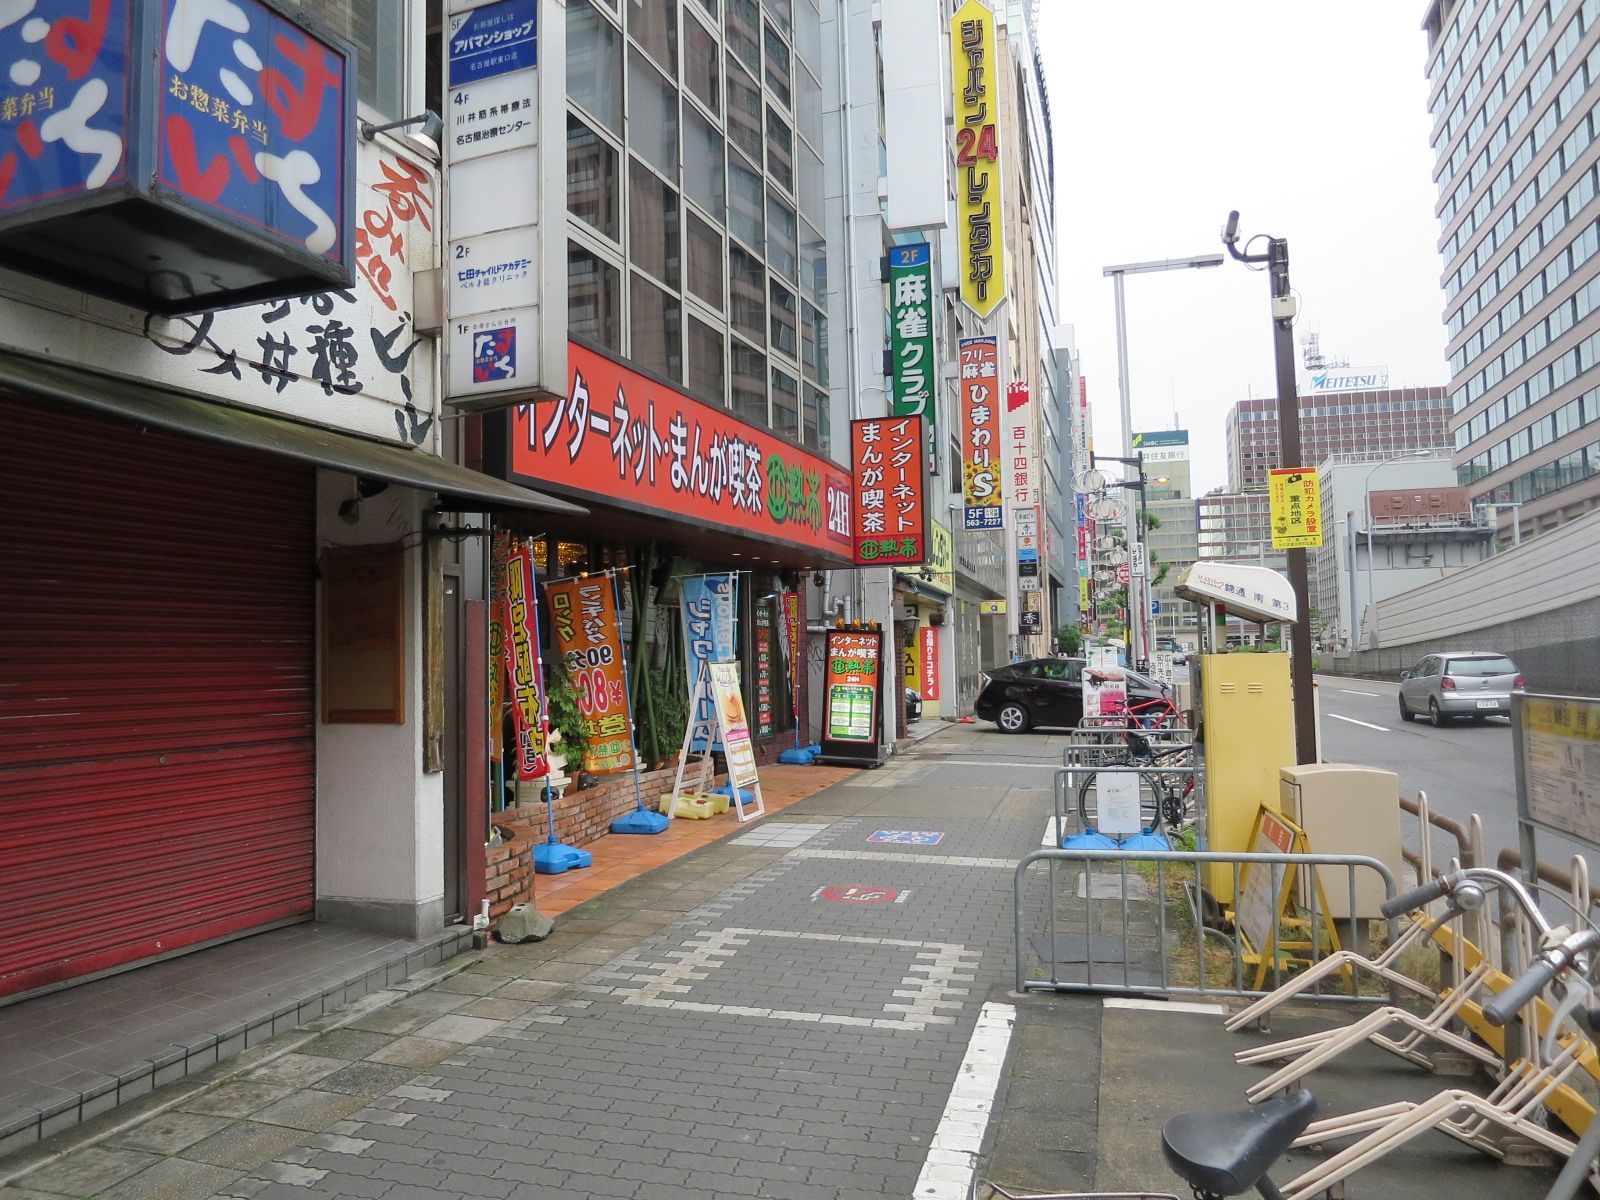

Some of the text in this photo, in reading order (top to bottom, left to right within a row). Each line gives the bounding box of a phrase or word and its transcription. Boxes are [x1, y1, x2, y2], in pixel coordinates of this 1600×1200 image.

[451, 18, 463, 31] 5F
[454, 20, 534, 55] アパマンショップ
[454, 92, 470, 105] 4F
[169, 75, 269, 146] お惣菜弁当
[456, 120, 531, 146] 名古屋治療センター
[455, 245, 470, 259] 2F
[901, 250, 918, 263] 2F
[458, 259, 532, 282] 七田チャイルドアカデミー
[457, 324, 469, 335] 1F
[895, 274, 930, 416] 麻雀クラブ
[961, 349, 995, 362] フリー
[962, 361, 996, 379] 麻雀
[1312, 372, 1377, 389] MEITETSU
[969, 383, 994, 498] ひまわりS
[1012, 426, 1029, 502] 百十四銀行
[860, 422, 886, 533] まんが喫茶
[890, 419, 916, 533] インターネット
[827, 485, 851, 537] 24H
[968, 508, 984, 519] 5F
[1290, 495, 1302, 525] 重点地区
[1303, 480, 1317, 533] 防犯カメラ設置
[966, 518, 1001, 527] 563-7227
[1023, 612, 1037, 624] 香
[830, 635, 878, 645] インターネット
[830, 648, 877, 659] まんが喫茶
[905, 653, 915, 676] 入口
[846, 675, 860, 683] 24H
